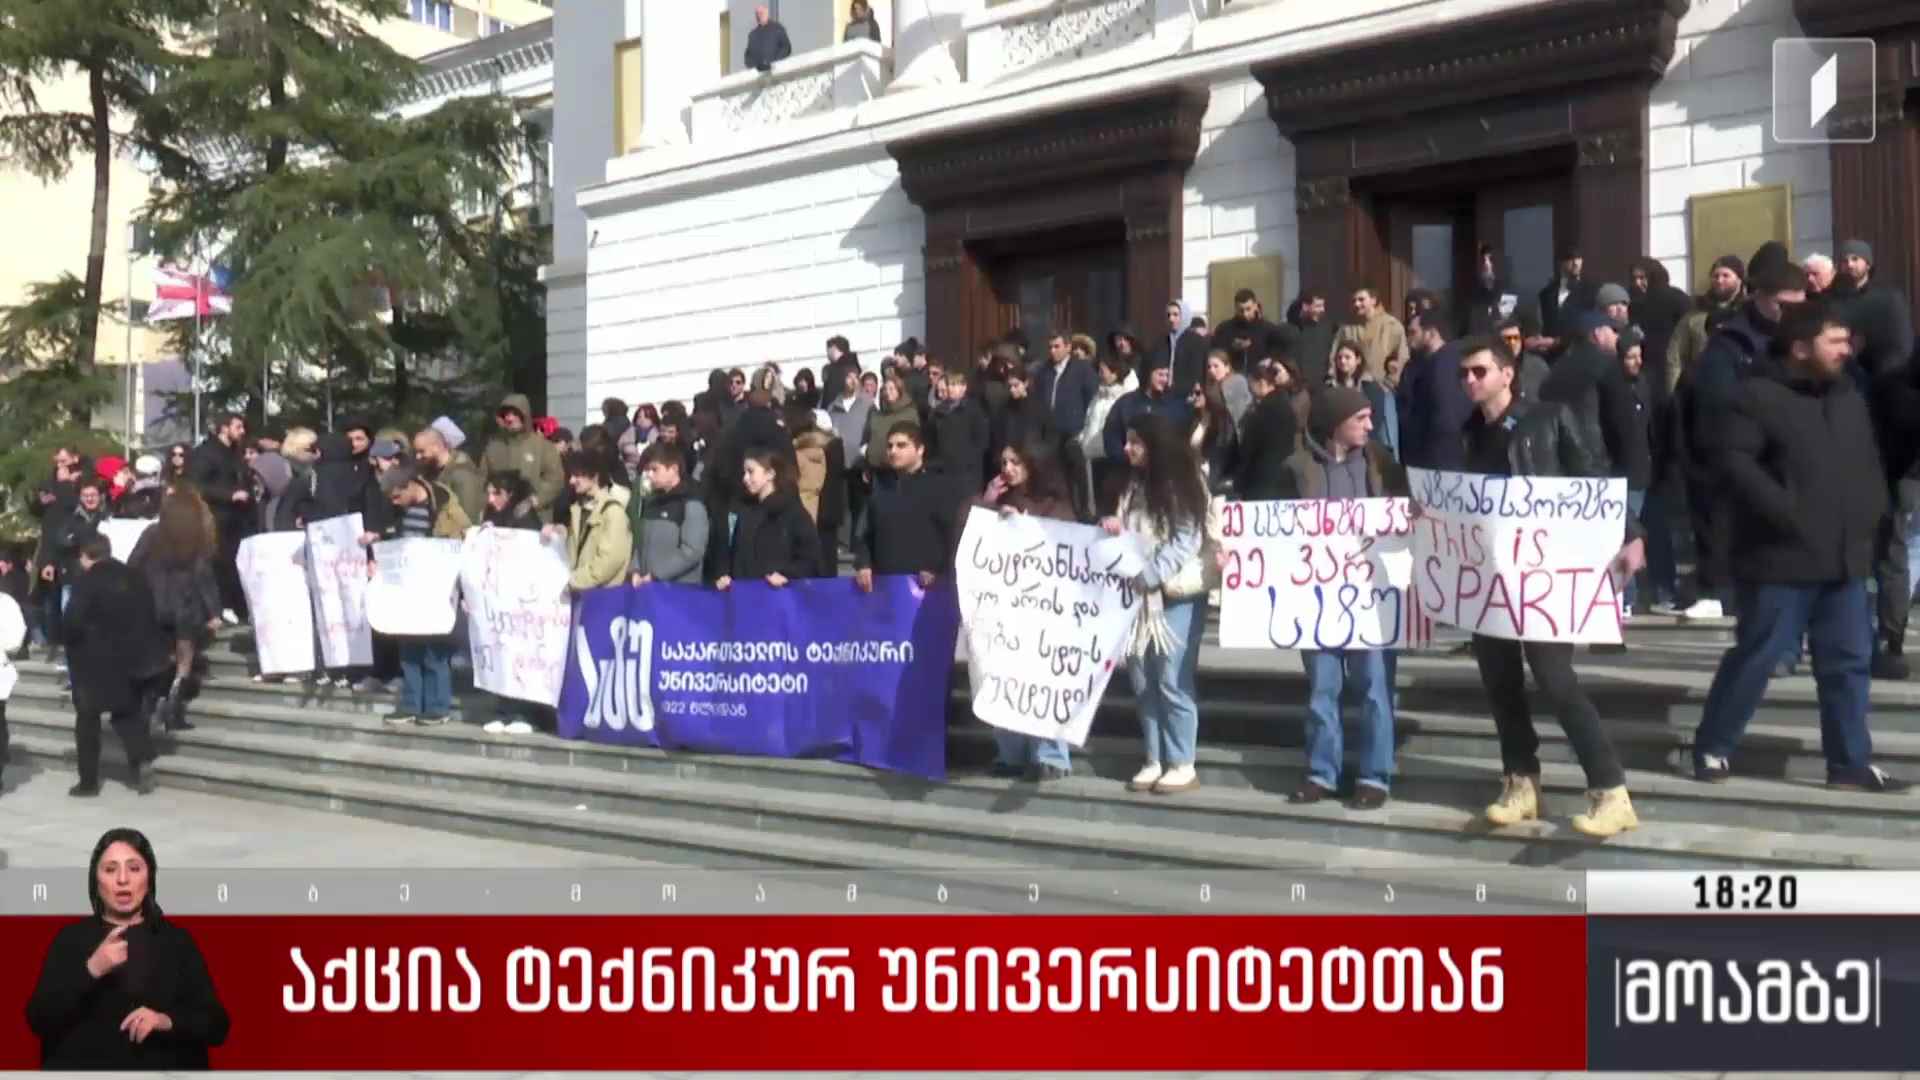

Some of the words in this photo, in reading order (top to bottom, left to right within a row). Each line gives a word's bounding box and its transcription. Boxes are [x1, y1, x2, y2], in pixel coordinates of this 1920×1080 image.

[1418, 470, 1624, 520] ატრანსპორტო
[1222, 502, 1244, 537] მე
[1226, 548, 1265, 589] მე
[1290, 537, 1375, 585] ვარ
[1424, 555, 1624, 639] SPARTA
[661, 640, 799, 663] საქართველოს
[658, 670, 808, 694] უნივერსიტეტი
